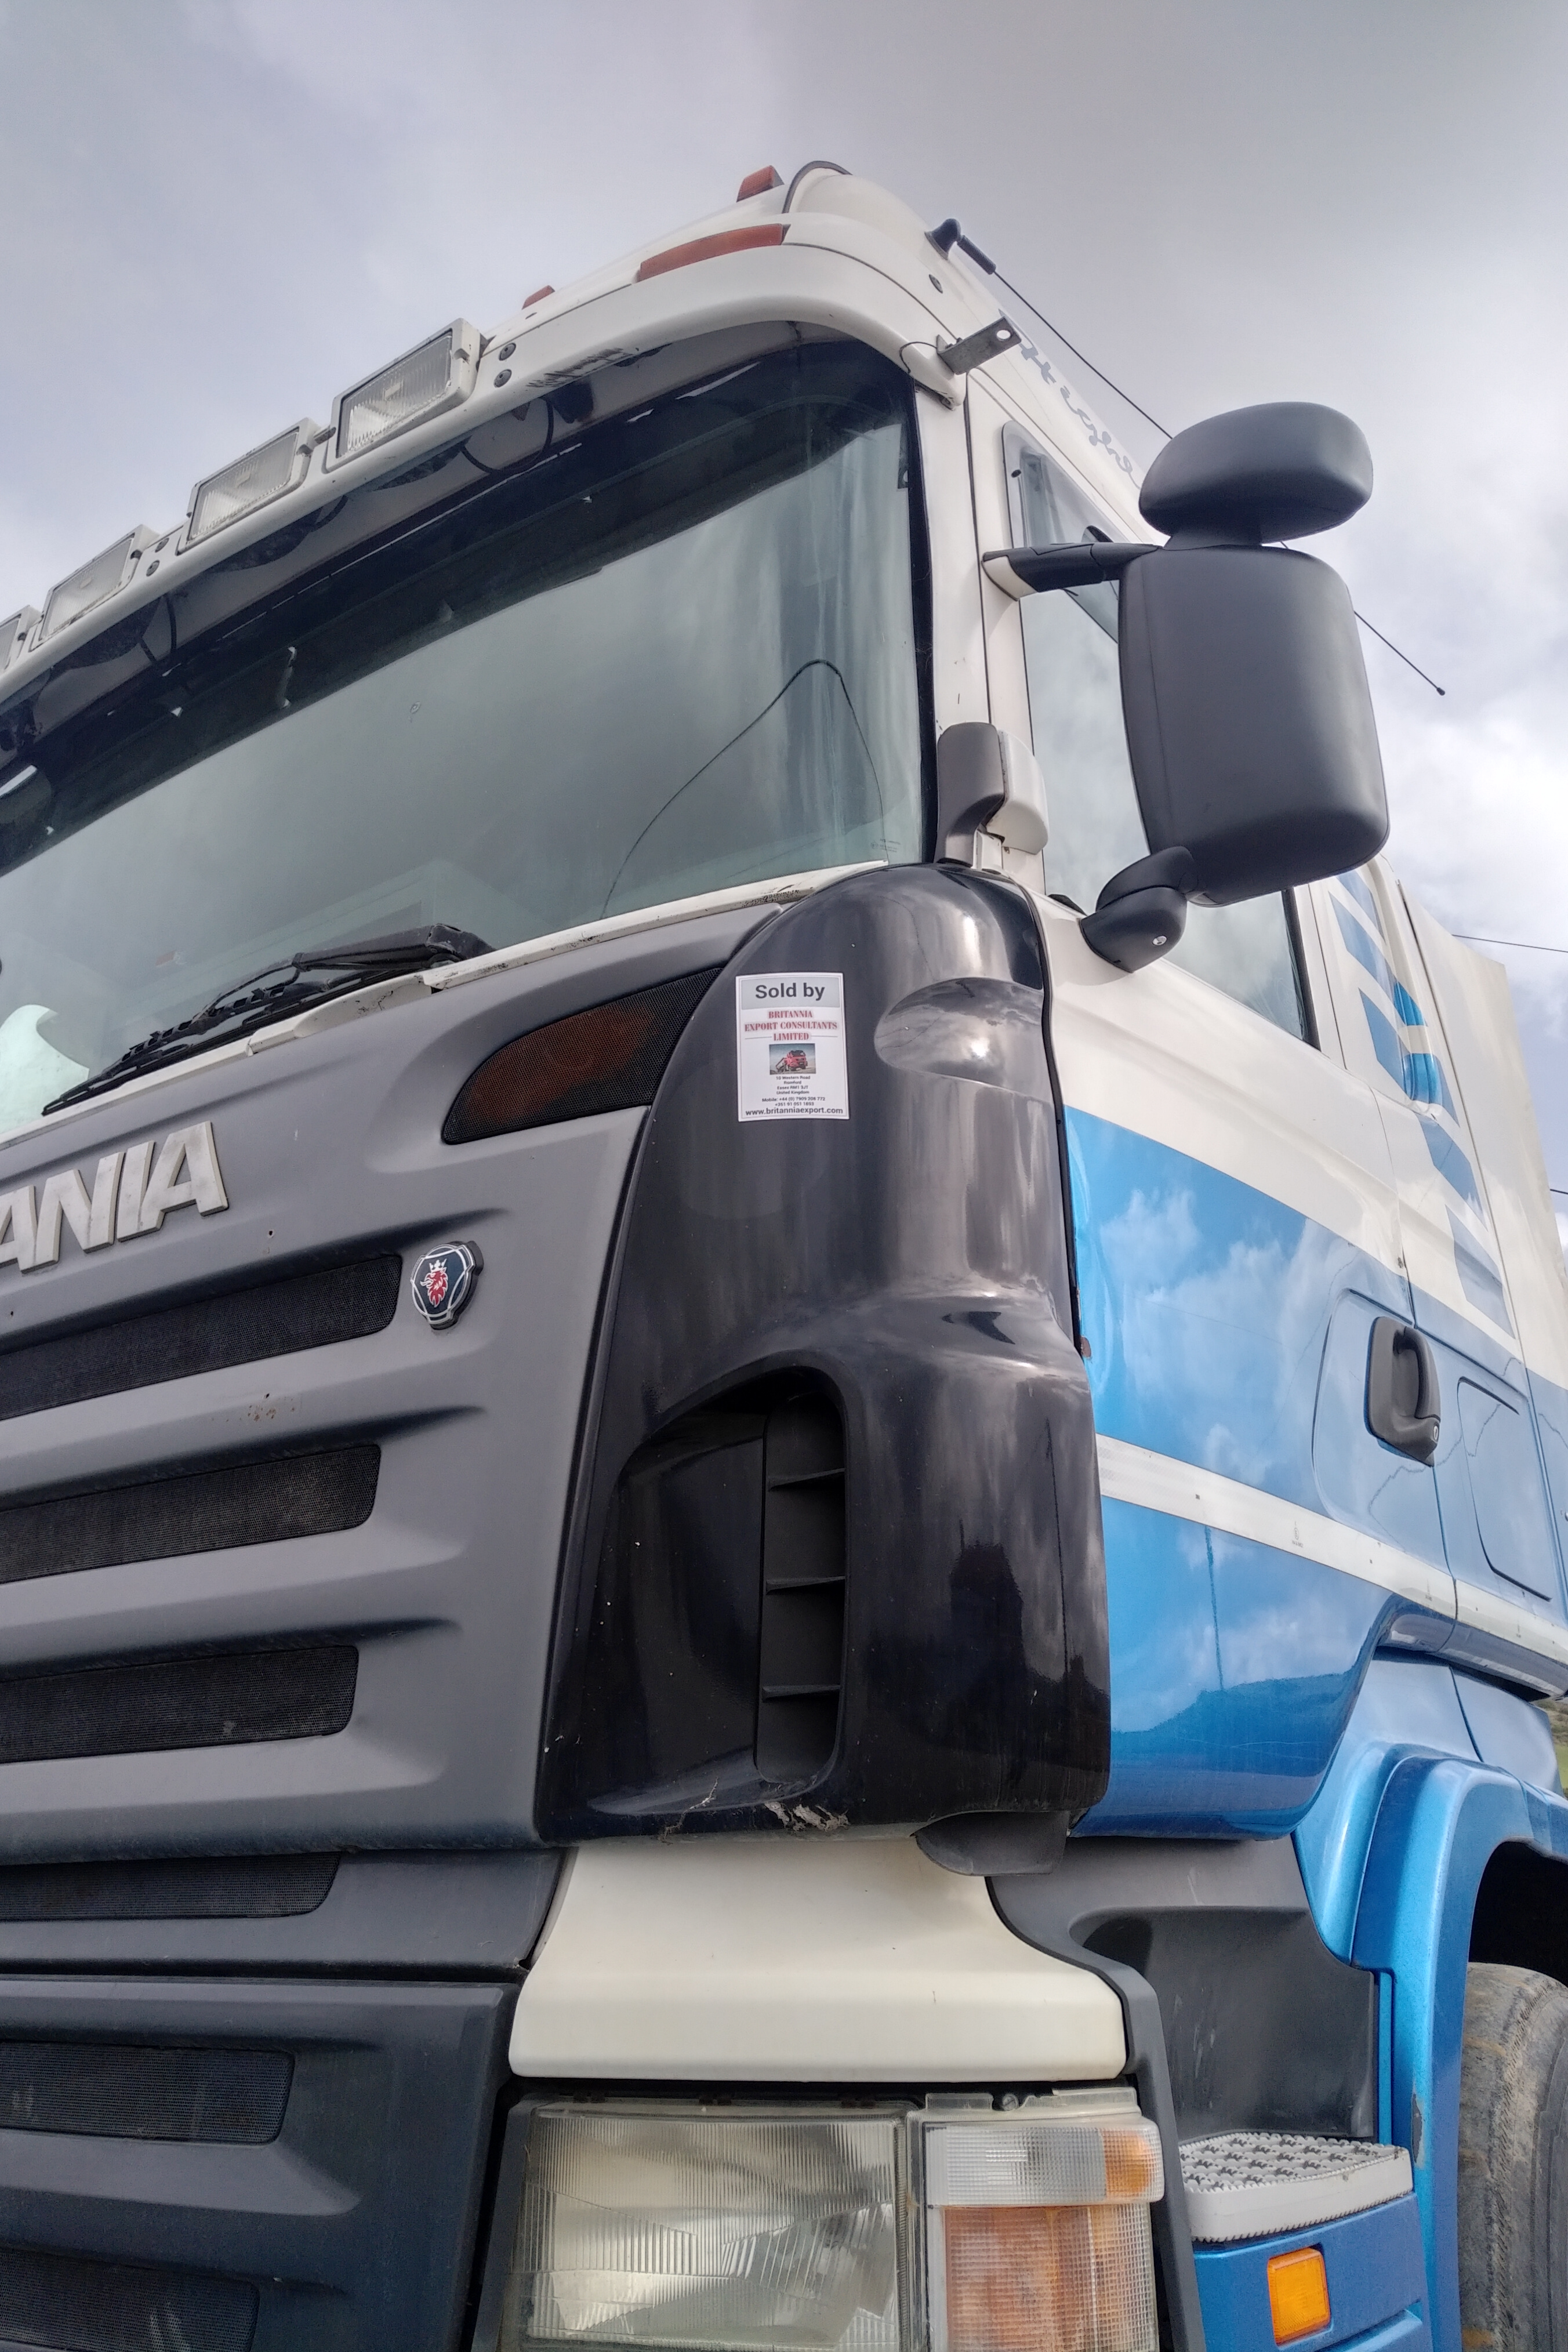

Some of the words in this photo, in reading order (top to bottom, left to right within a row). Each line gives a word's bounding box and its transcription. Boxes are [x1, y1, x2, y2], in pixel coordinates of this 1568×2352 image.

[756, 983, 796, 999] Sold
[804, 983, 825, 1001] by
[768, 1010, 812, 1019] BRITANNIA
[745, 1022, 778, 1032] EXPORT
[774, 1033, 809, 1041] LIMITED
[746, 1106, 843, 1116] www.britanniaexport.com
